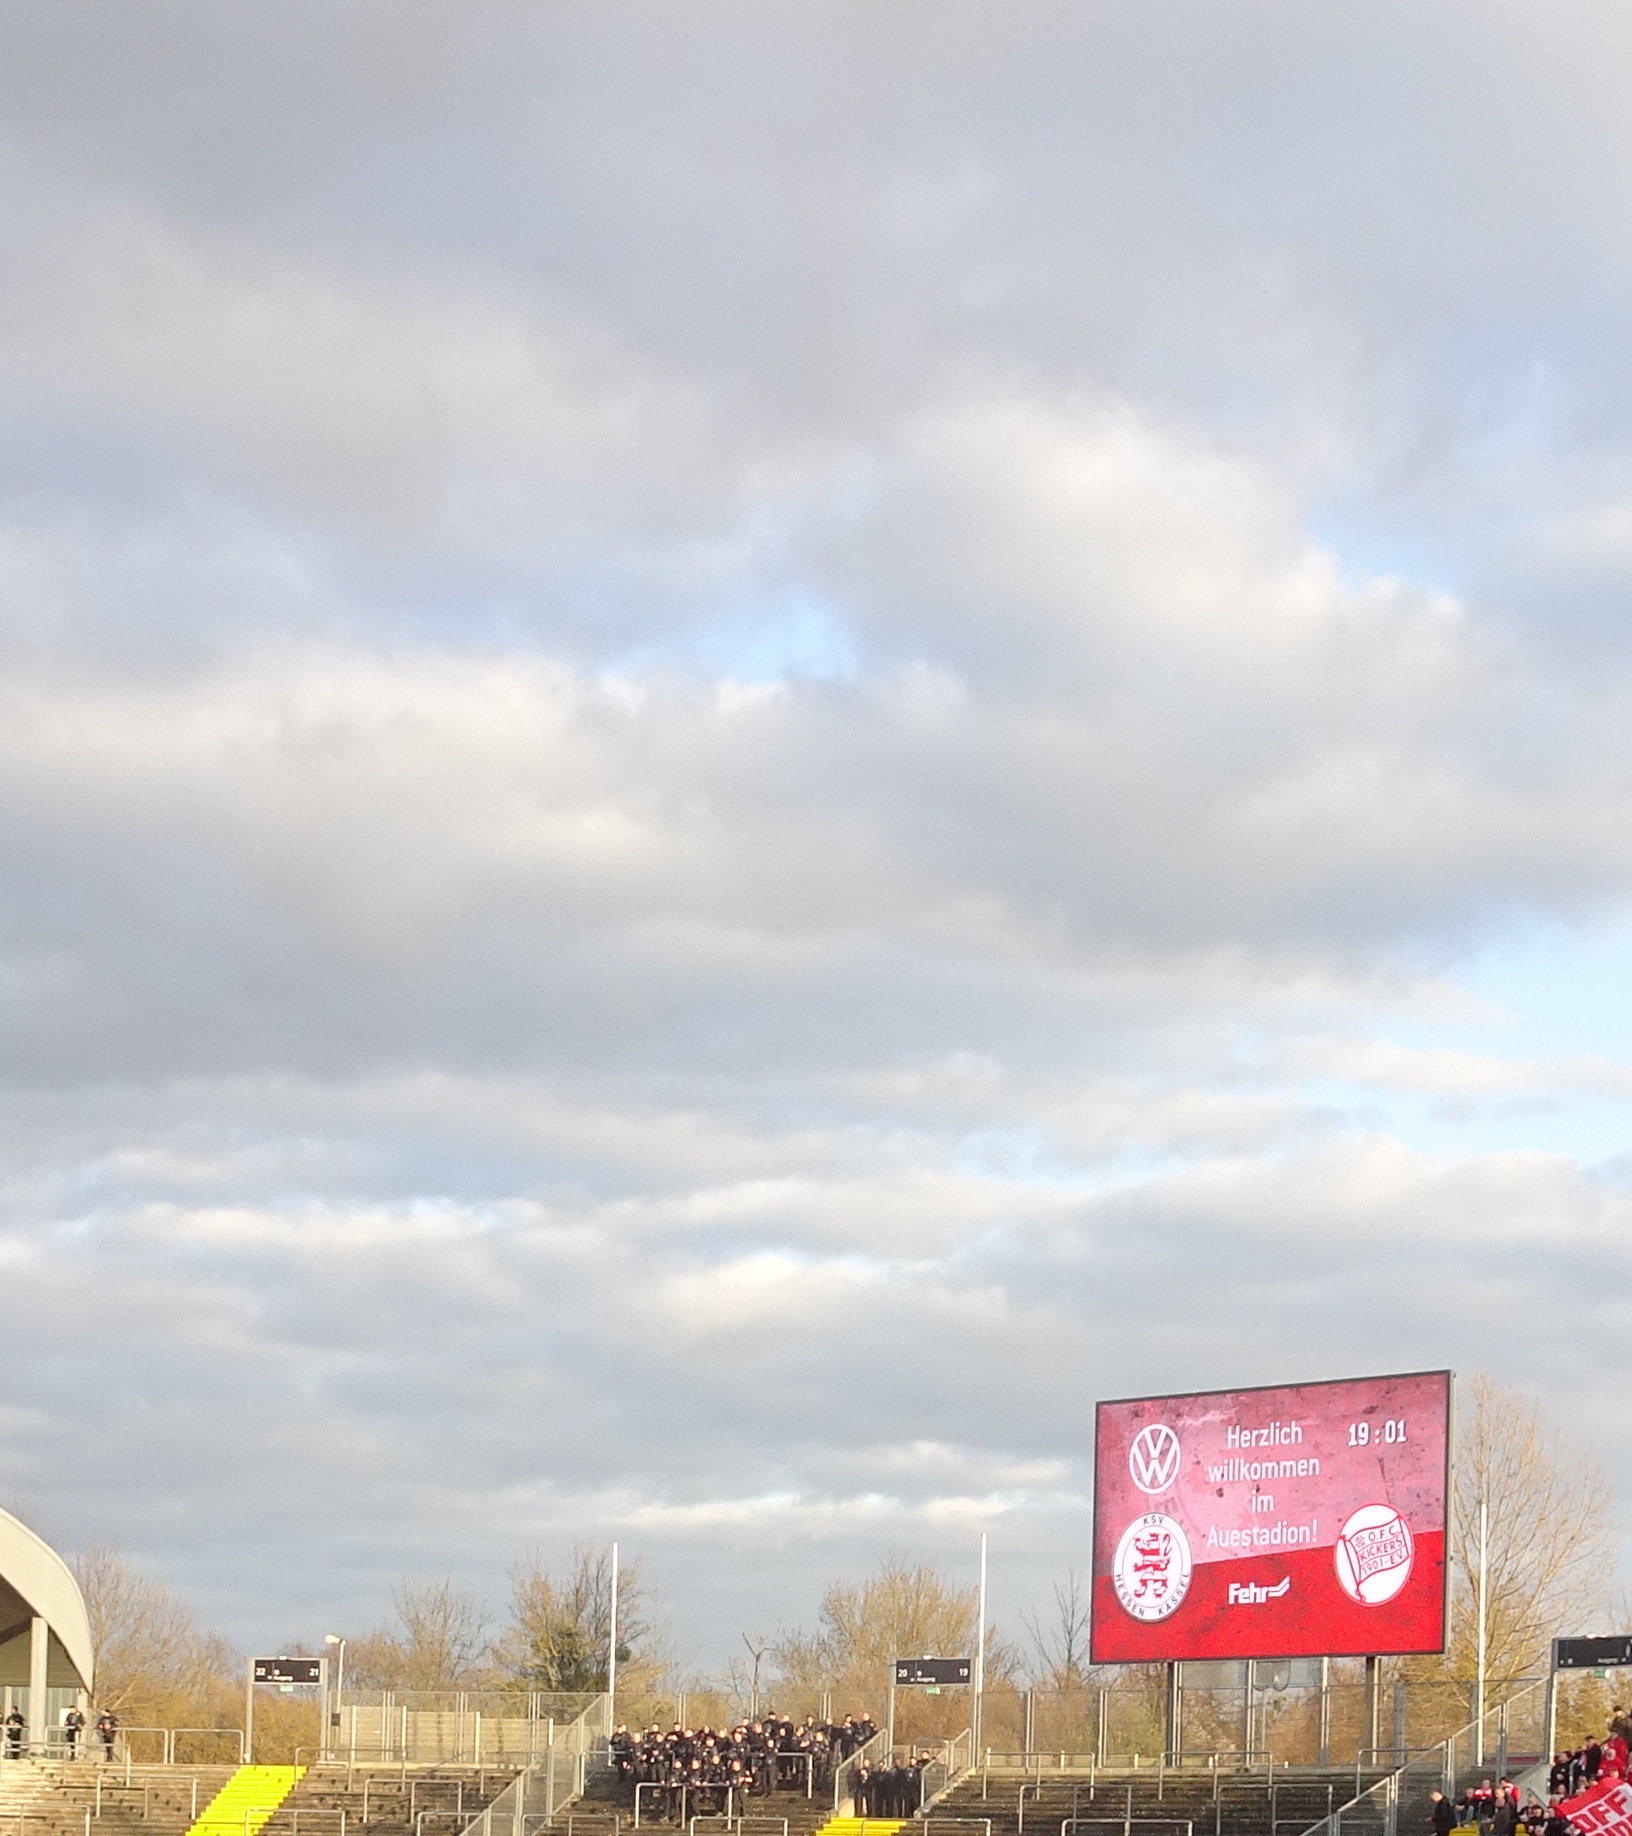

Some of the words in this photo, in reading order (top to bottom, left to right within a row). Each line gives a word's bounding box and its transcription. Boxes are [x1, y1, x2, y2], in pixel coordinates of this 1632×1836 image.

[1227, 1420, 1303, 1449] Herzlich
[1208, 1458, 1320, 1483] willkommen
[1251, 1490, 1274, 1513] im
[1143, 1515, 1164, 1526] KSV
[1207, 1519, 1318, 1549] Auestadion!
[1360, 1536, 1403, 1562] KICKERS
[1116, 1573, 1146, 1617] HESSEN
[1158, 1572, 1190, 1616] KASSEL
[1229, 1581, 1271, 1605] Fehr
[1571, 1789, 1629, 1833] OFF
